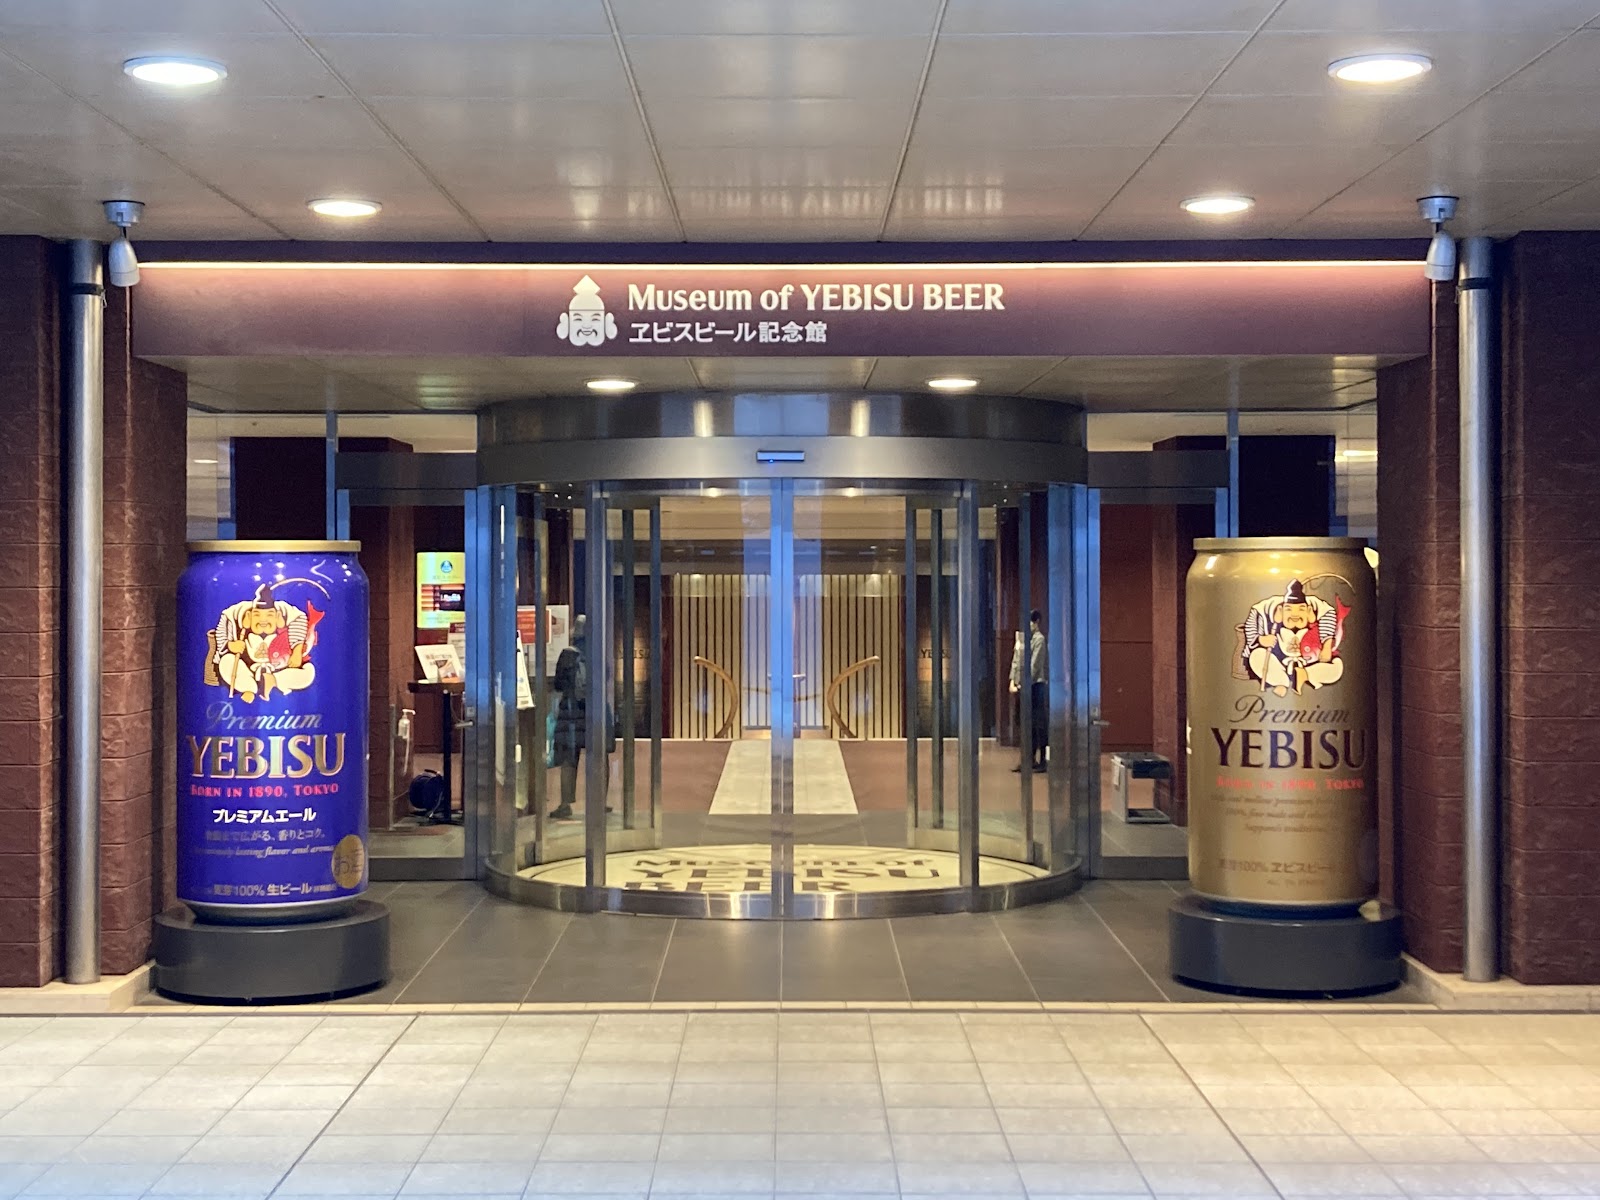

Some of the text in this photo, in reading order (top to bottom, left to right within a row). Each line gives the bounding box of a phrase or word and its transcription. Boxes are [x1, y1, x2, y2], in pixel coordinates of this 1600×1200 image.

[628, 283, 1005, 311] Museum of YEBISU BEER
[629, 321, 827, 343] ヱビスビール記念館
[206, 701, 323, 730] Premium
[1229, 695, 1349, 723] Premium
[186, 732, 346, 778] YEBISU
[1211, 727, 1367, 769] YEBISU
[227, 786, 242, 798] IN
[293, 783, 339, 796] TOKYO
[212, 807, 317, 824] プレミアムエール
